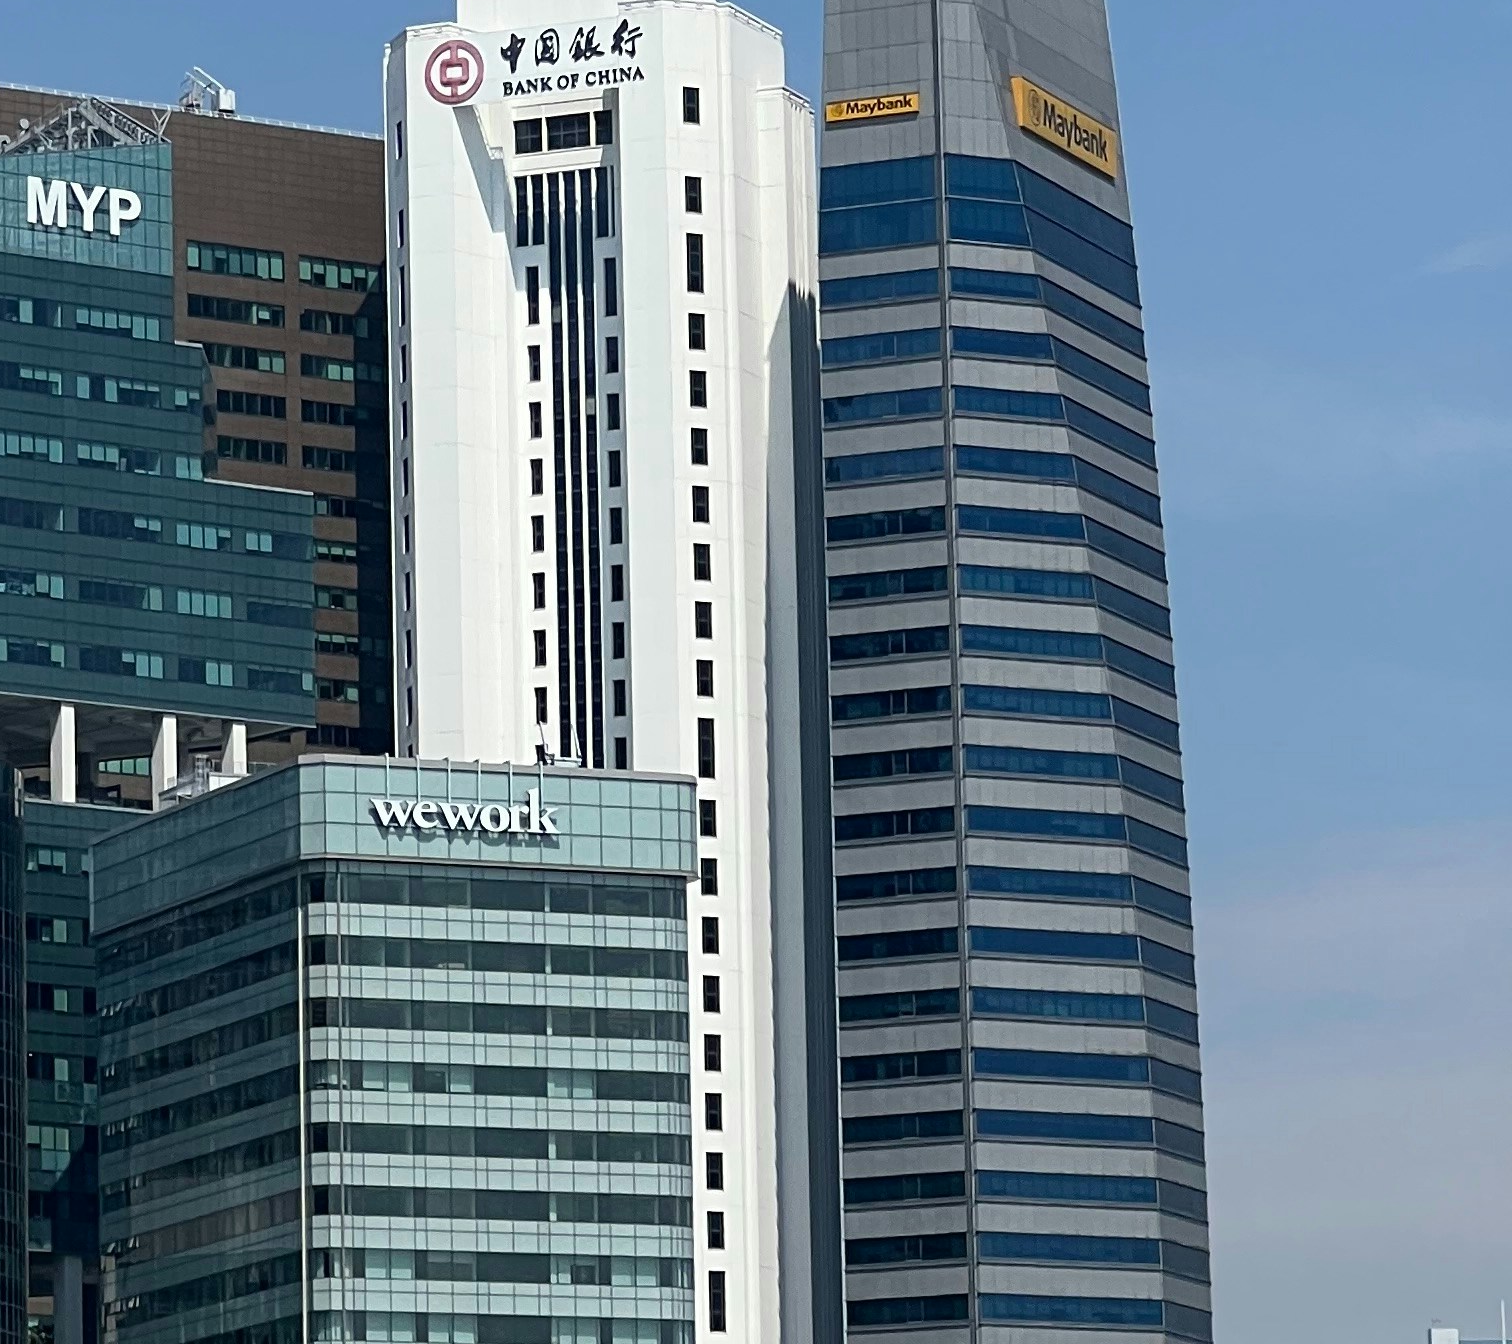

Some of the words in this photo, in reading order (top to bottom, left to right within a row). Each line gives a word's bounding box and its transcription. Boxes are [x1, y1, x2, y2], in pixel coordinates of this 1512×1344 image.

[502, 76, 553, 98] BANK
[556, 72, 580, 90] OF
[585, 65, 645, 87] CHINA
[846, 94, 913, 115] Maybank
[1042, 98, 1109, 162] Maybank
[26, 175, 143, 237] MYP
[369, 787, 562, 835] wework
